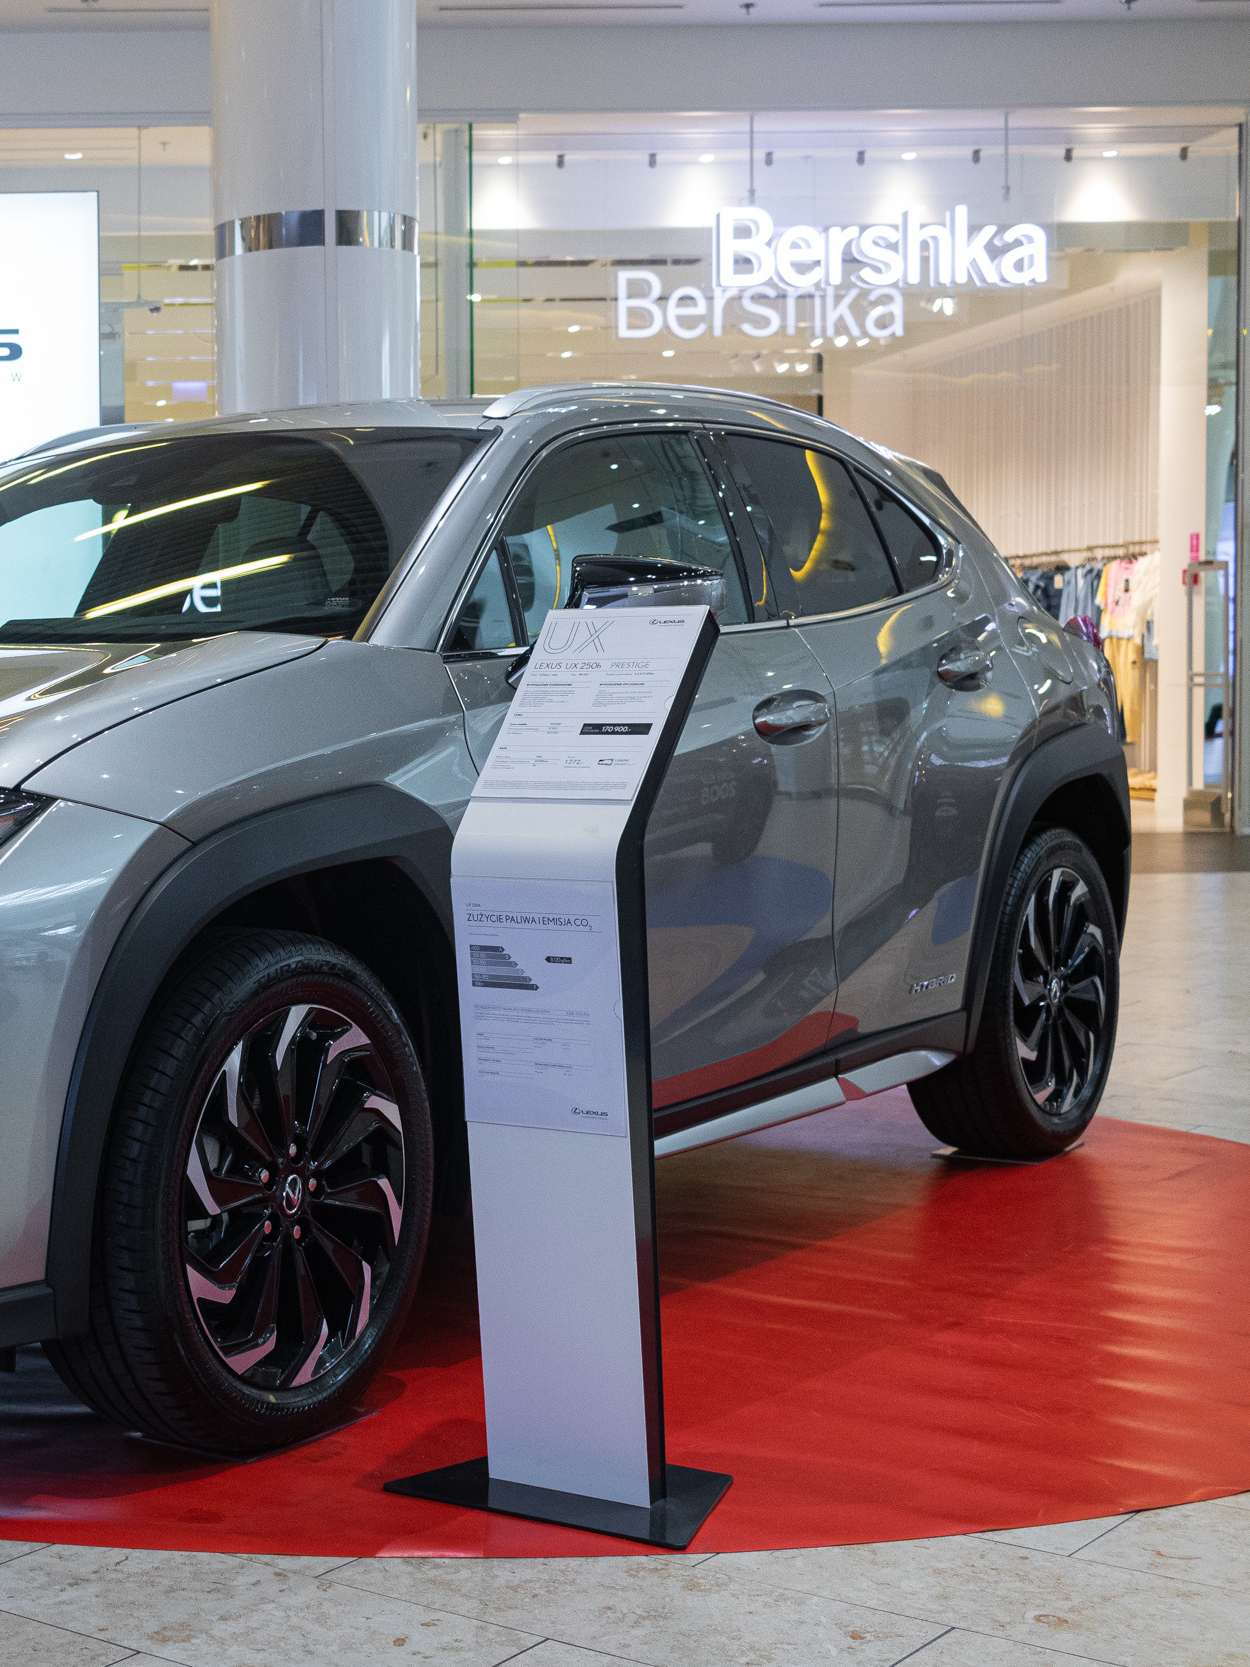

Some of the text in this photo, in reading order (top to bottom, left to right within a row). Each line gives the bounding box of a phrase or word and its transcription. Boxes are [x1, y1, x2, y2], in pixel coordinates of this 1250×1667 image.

[714, 204, 1048, 289] Bershka
[543, 620, 614, 654] UX
[534, 661, 651, 670] LEXUS UX 250h PRESTIGE
[467, 912, 504, 923] ZUŻYCIE
[505, 914, 537, 925] PALIWA
[542, 916, 573, 927] EMISJA
